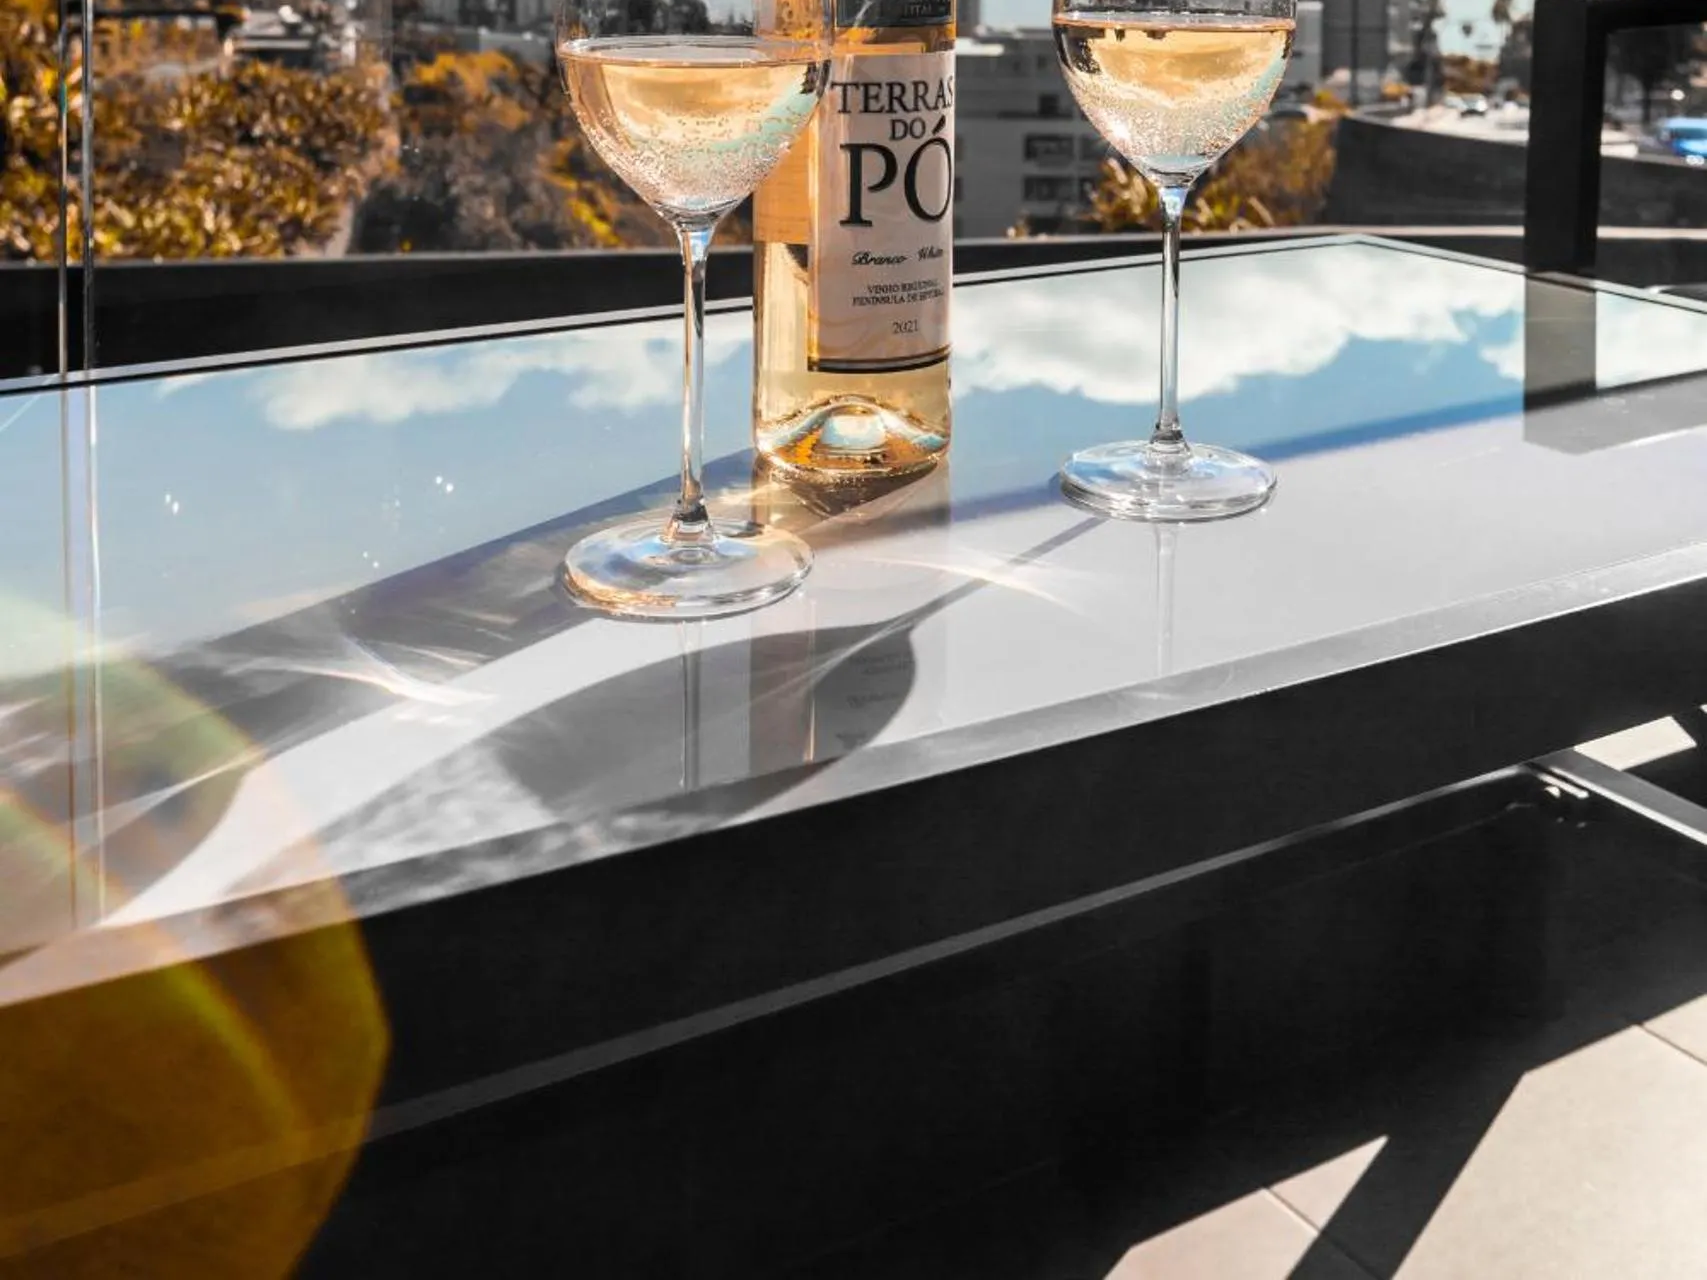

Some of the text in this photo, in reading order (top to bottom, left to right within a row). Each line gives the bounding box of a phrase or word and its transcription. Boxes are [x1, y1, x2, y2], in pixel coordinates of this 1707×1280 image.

[830, 75, 953, 114] TERRAS
[888, 117, 926, 142] DO
[838, 114, 952, 228] PÓ
[852, 251, 907, 266] Branco
